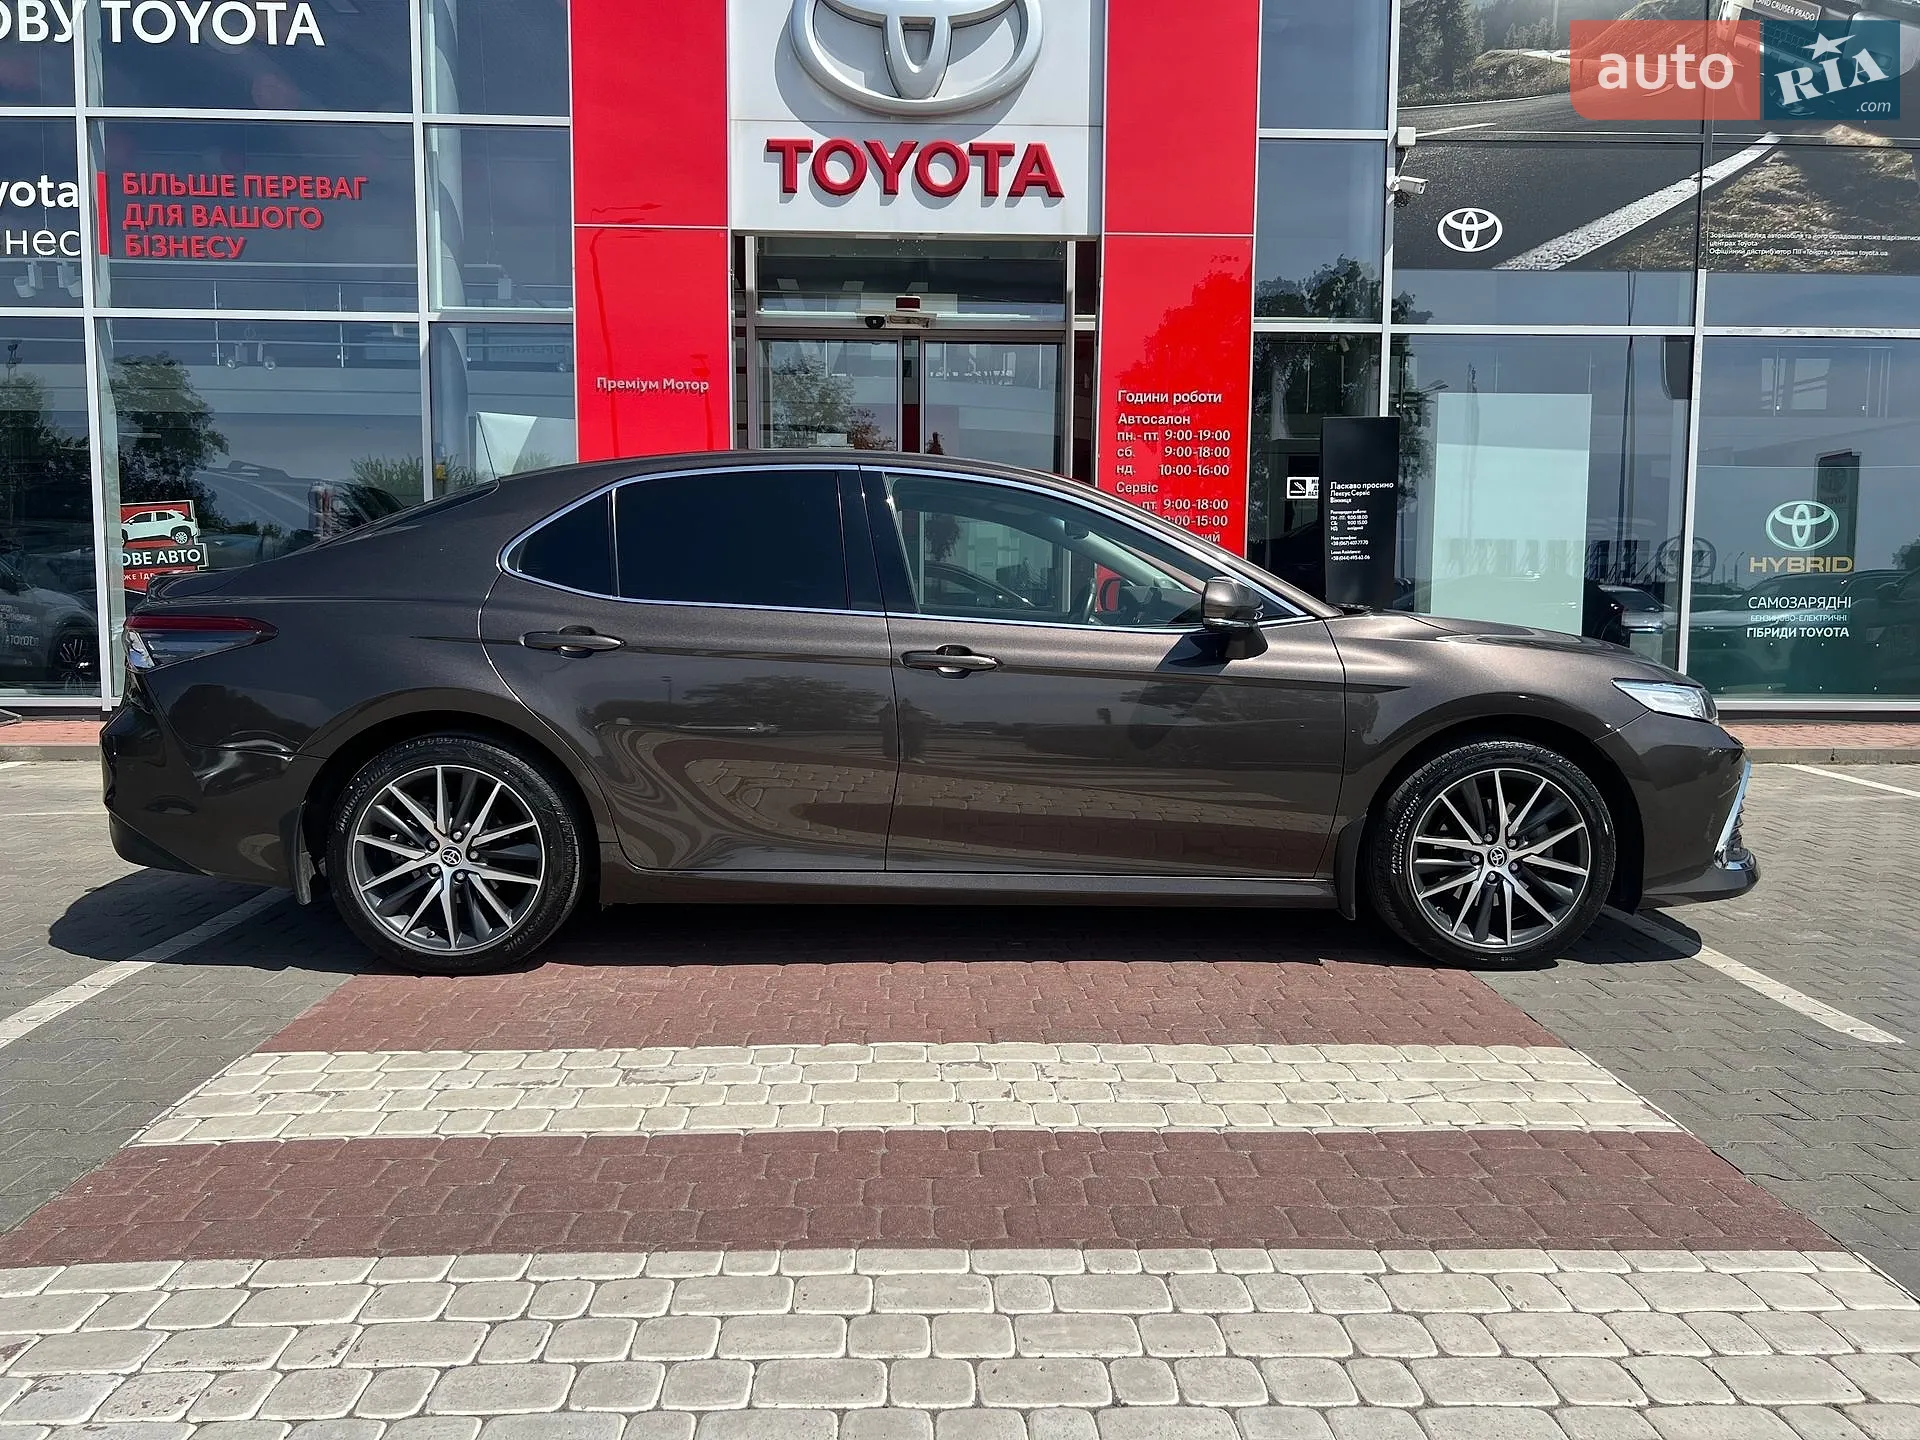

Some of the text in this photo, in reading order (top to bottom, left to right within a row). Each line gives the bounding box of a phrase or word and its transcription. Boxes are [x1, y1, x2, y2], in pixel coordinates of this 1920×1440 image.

[0, 0, 325, 46] ВУ TOYOTA
[766, 138, 1065, 197] TOYOTA
[122, 172, 368, 199] БІЛЬШЕ ПЕРЕВАГ
[122, 203, 322, 230] ДЛЯ ВАШОГО
[124, 234, 245, 258] БІЗНЕСУ
[596, 377, 709, 392] Преміум Мотор
[1117, 390, 1222, 405] Години роботи
[1118, 412, 1190, 425] Автосалон
[1117, 446, 1136, 458] сб.
[1116, 464, 1136, 476] нд.
[1116, 482, 1158, 495] Сервіс
[156, 549, 200, 564] АВТО
[1750, 556, 1853, 573] HYBRID
[1748, 596, 1852, 610] САМОЗАРЯДНІ
[1746, 627, 1850, 639] ГІБРИДИ TOYOTA
